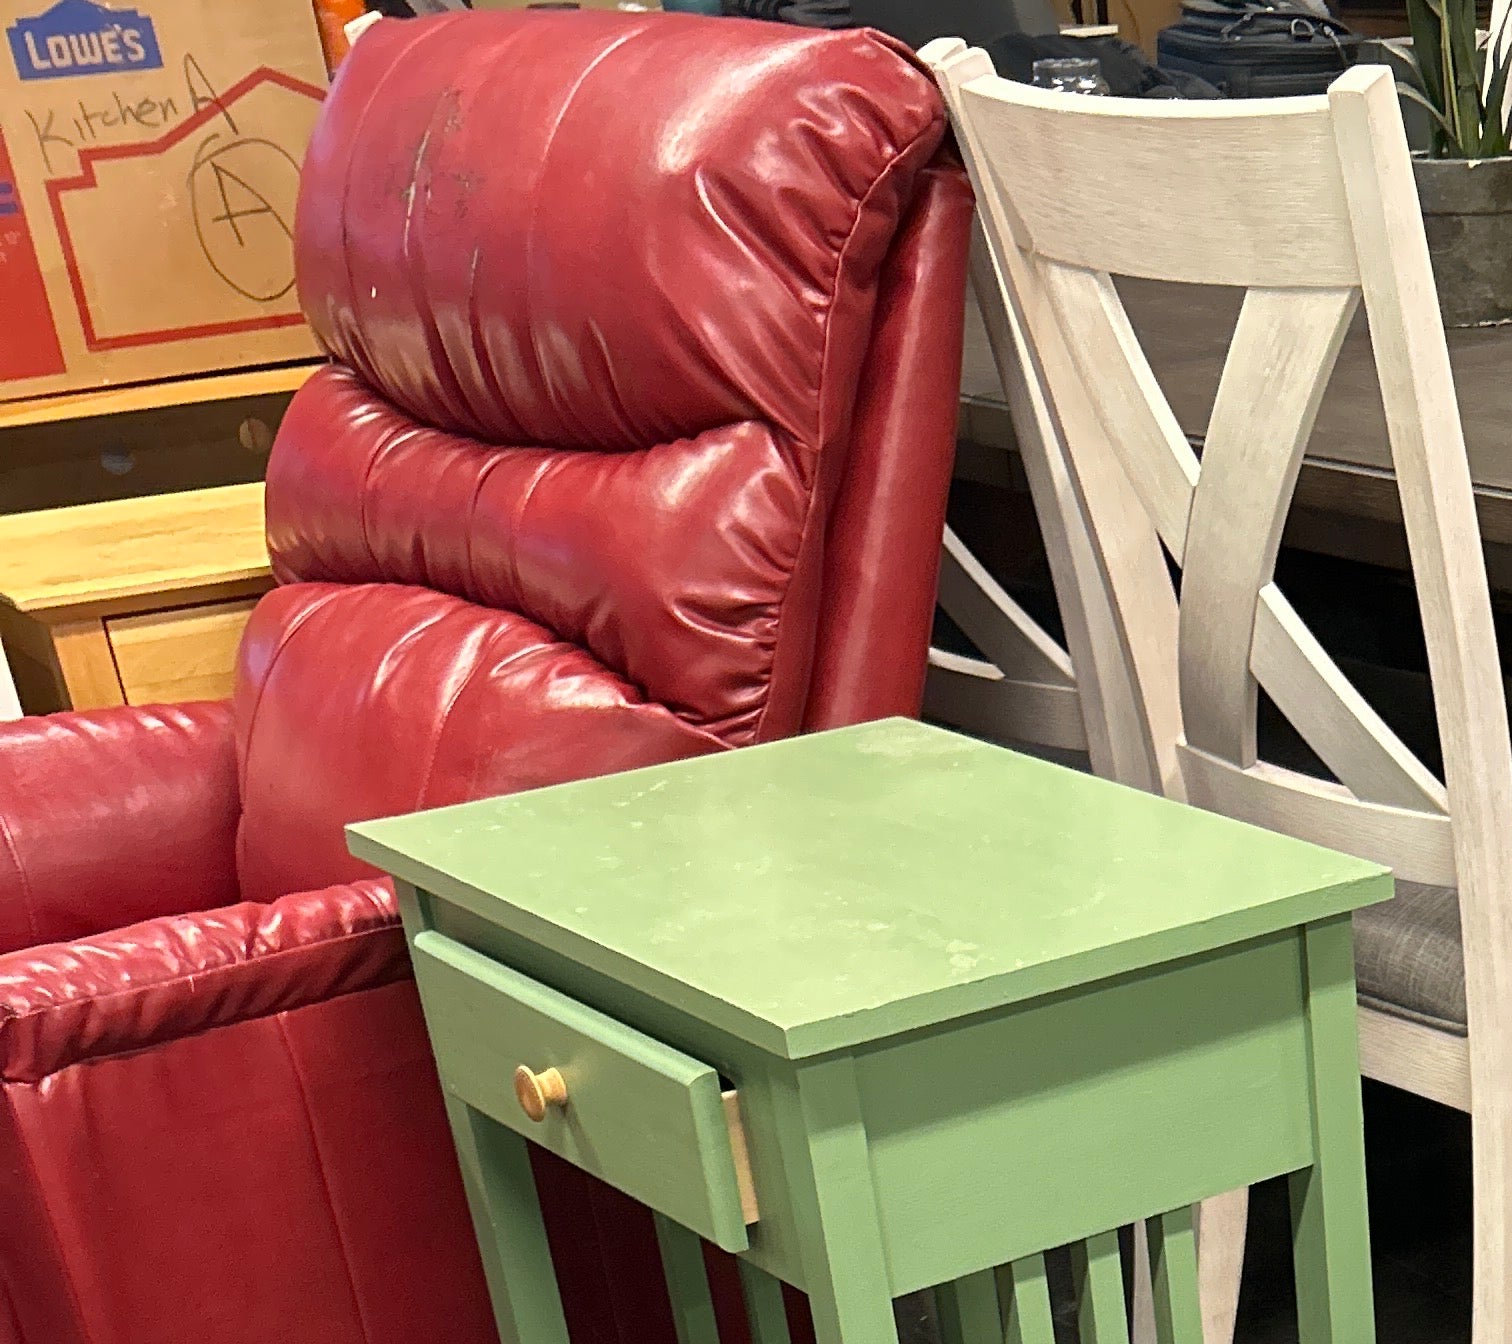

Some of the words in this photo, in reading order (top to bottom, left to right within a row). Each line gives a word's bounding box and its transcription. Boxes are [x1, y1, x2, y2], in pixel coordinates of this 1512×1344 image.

[25, 24, 145, 70] LOWE'S
[25, 92, 178, 174] Kitchen
[184, 52, 238, 135] A
[211, 160, 295, 247] A
